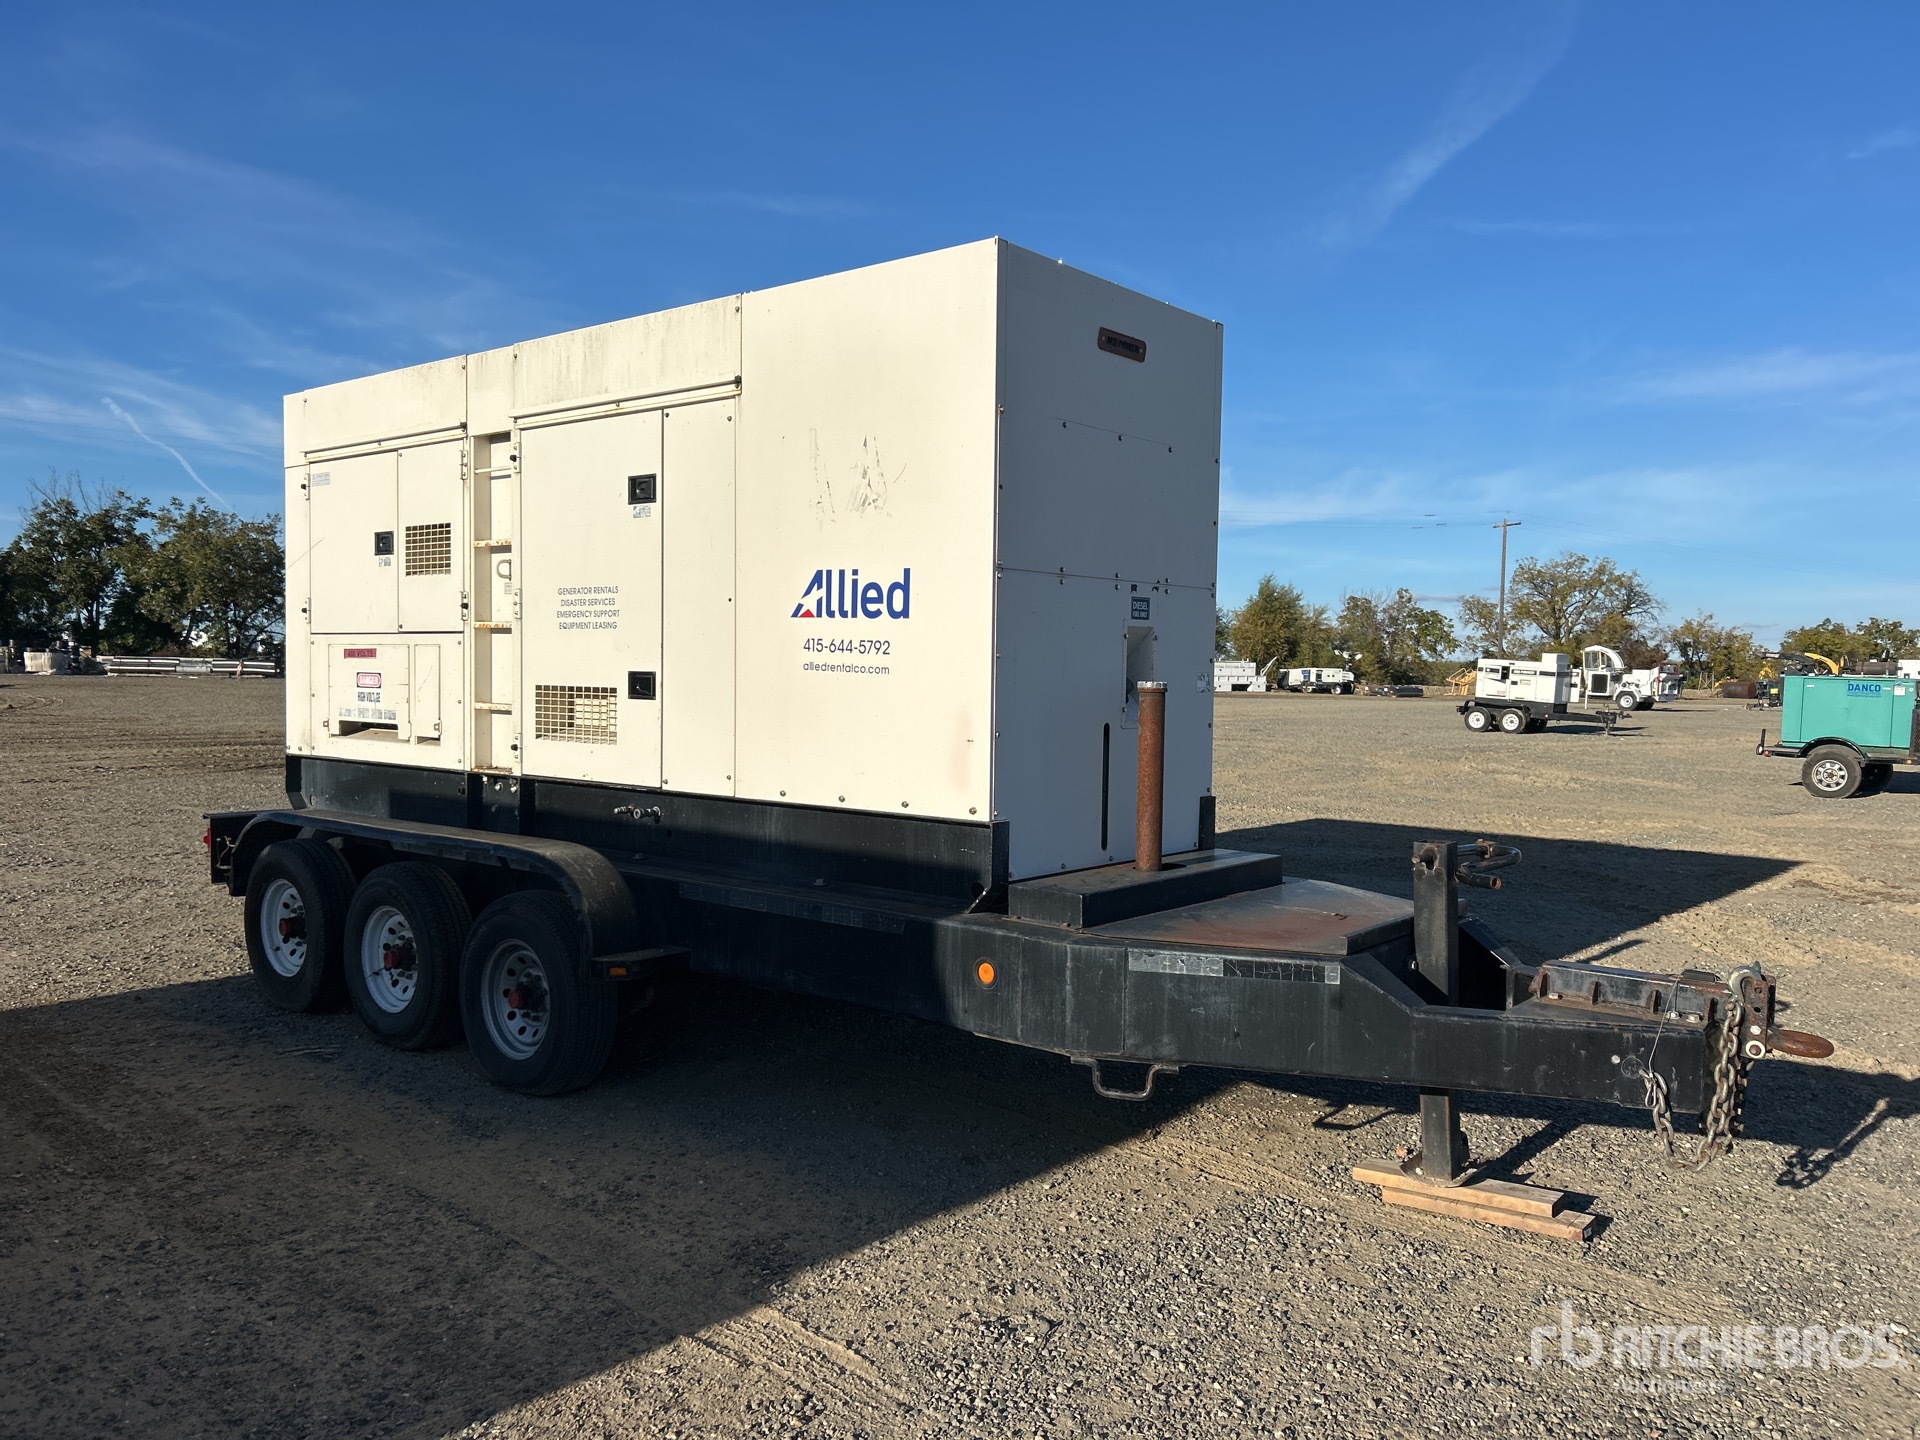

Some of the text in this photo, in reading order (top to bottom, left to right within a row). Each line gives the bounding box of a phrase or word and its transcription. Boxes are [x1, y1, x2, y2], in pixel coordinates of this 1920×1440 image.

[557, 585, 619, 596] GENERATOR RENTALS
[790, 567, 911, 620] Allied
[560, 597, 616, 607] DISASTER SERVICES
[1132, 601, 1148, 611] DIESEL
[556, 609, 620, 619] EMERGENCY SUPPORT
[558, 621, 618, 630] EQUIPMENT LEASING
[803, 637, 891, 656] 415-644-5792
[356, 650, 374, 658] VOLTS
[802, 661, 890, 675] alliedrentalco.com
[1848, 683, 1881, 692] DANCO
